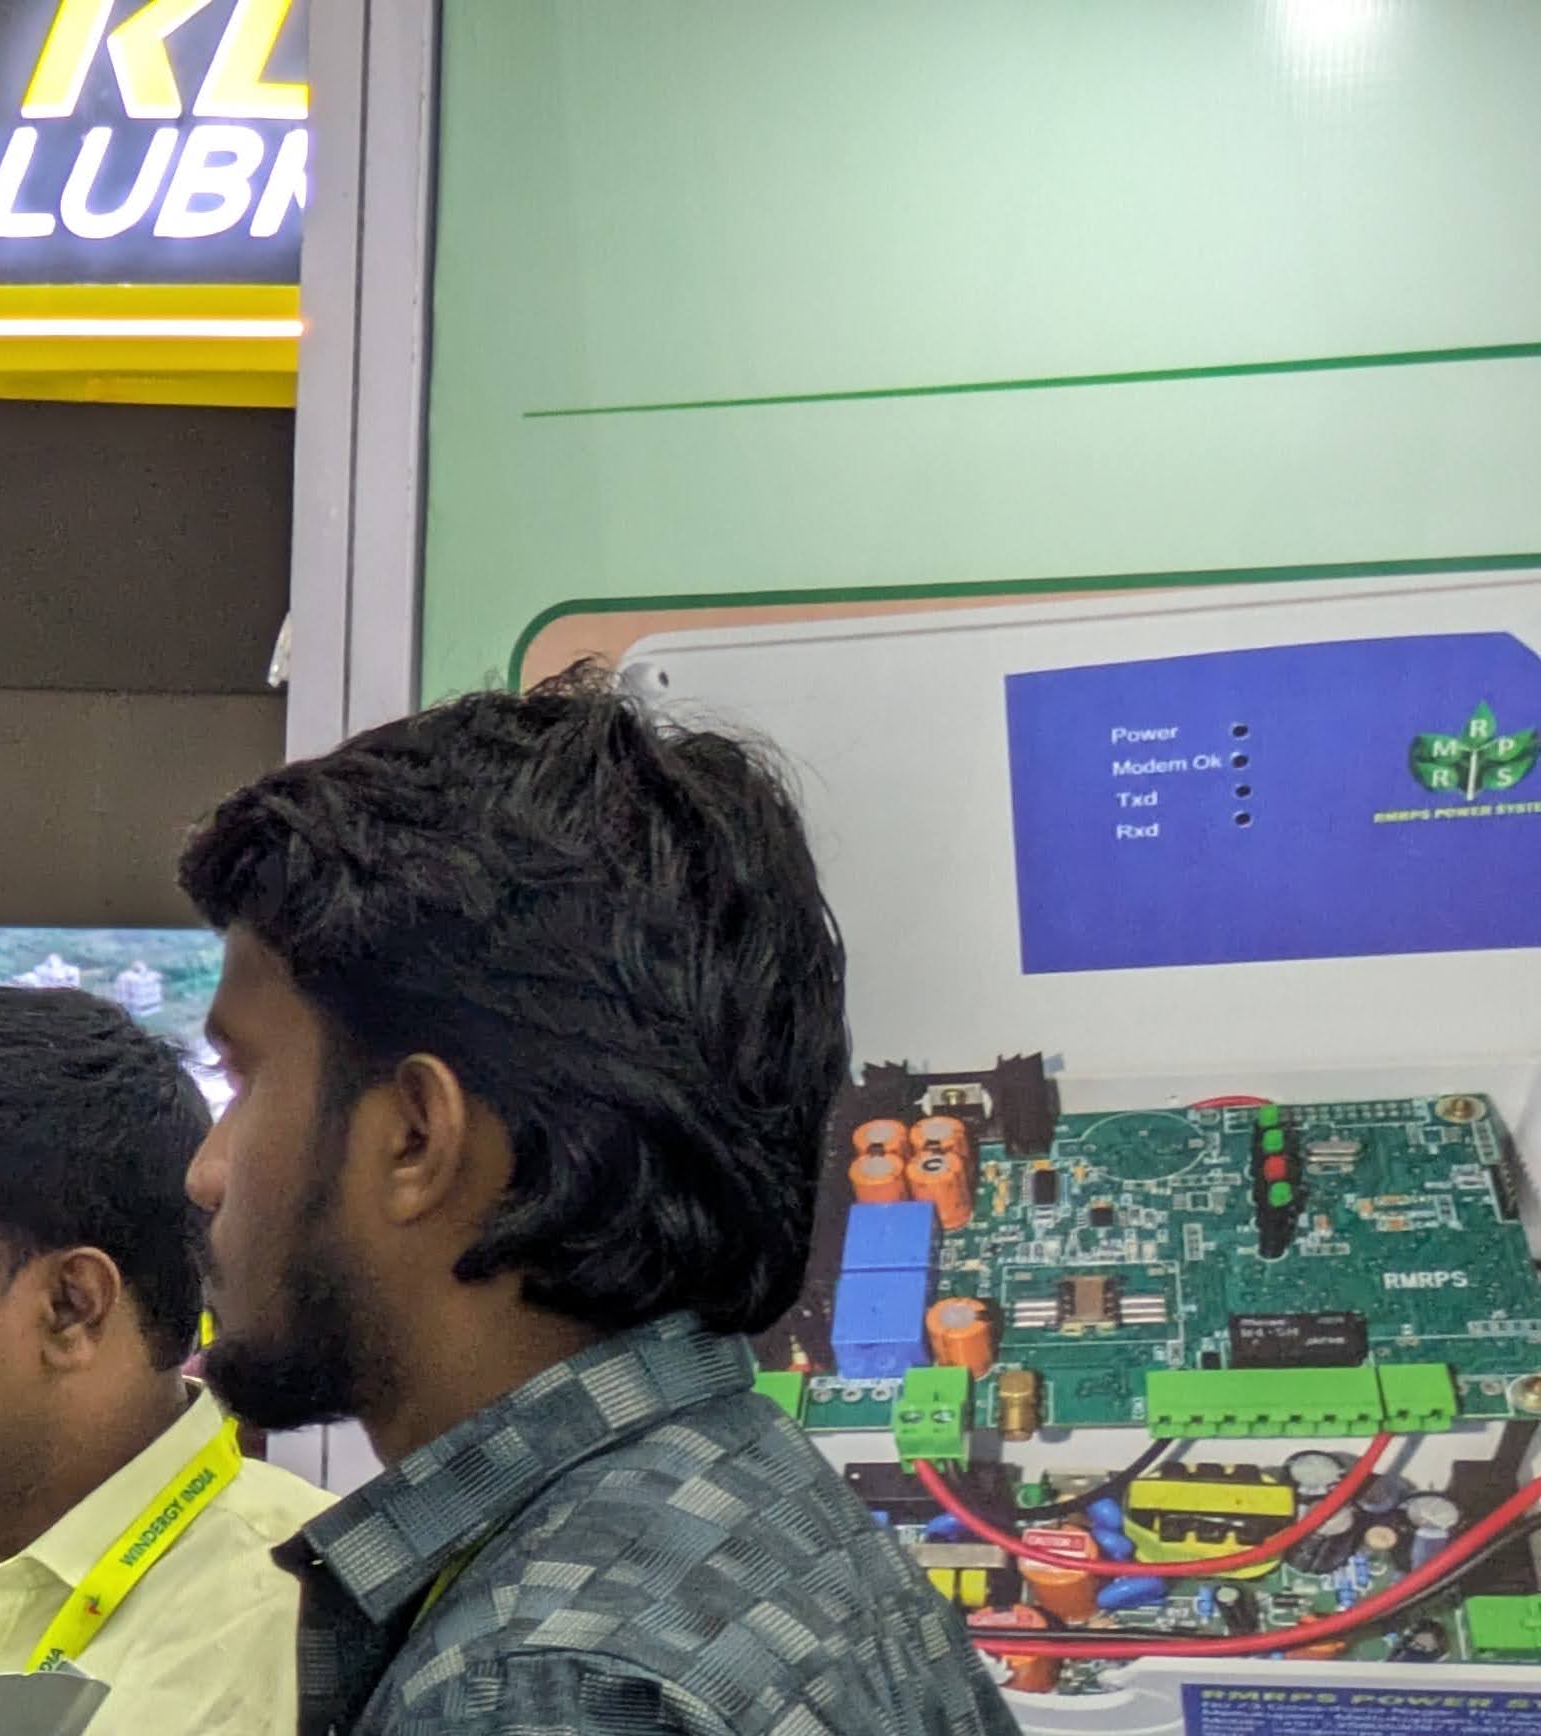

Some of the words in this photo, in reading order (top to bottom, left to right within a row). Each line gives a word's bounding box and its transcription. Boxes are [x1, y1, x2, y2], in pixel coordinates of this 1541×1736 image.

[1111, 726, 1179, 745] Power
[1468, 718, 1488, 739] R
[1431, 738, 1459, 759] M
[1497, 737, 1516, 757] P
[1192, 753, 1223, 770] Ok
[1431, 768, 1450, 788] R
[1496, 767, 1513, 787] S
[1116, 789, 1158, 808] Txd
[1116, 822, 1160, 840] Rxd
[1381, 1269, 1469, 1291] RMRPS
[119, 1498, 185, 1567] WINDERGY
[180, 1466, 218, 1504] INDIA
[1351, 1693, 1494, 1710] POWER
